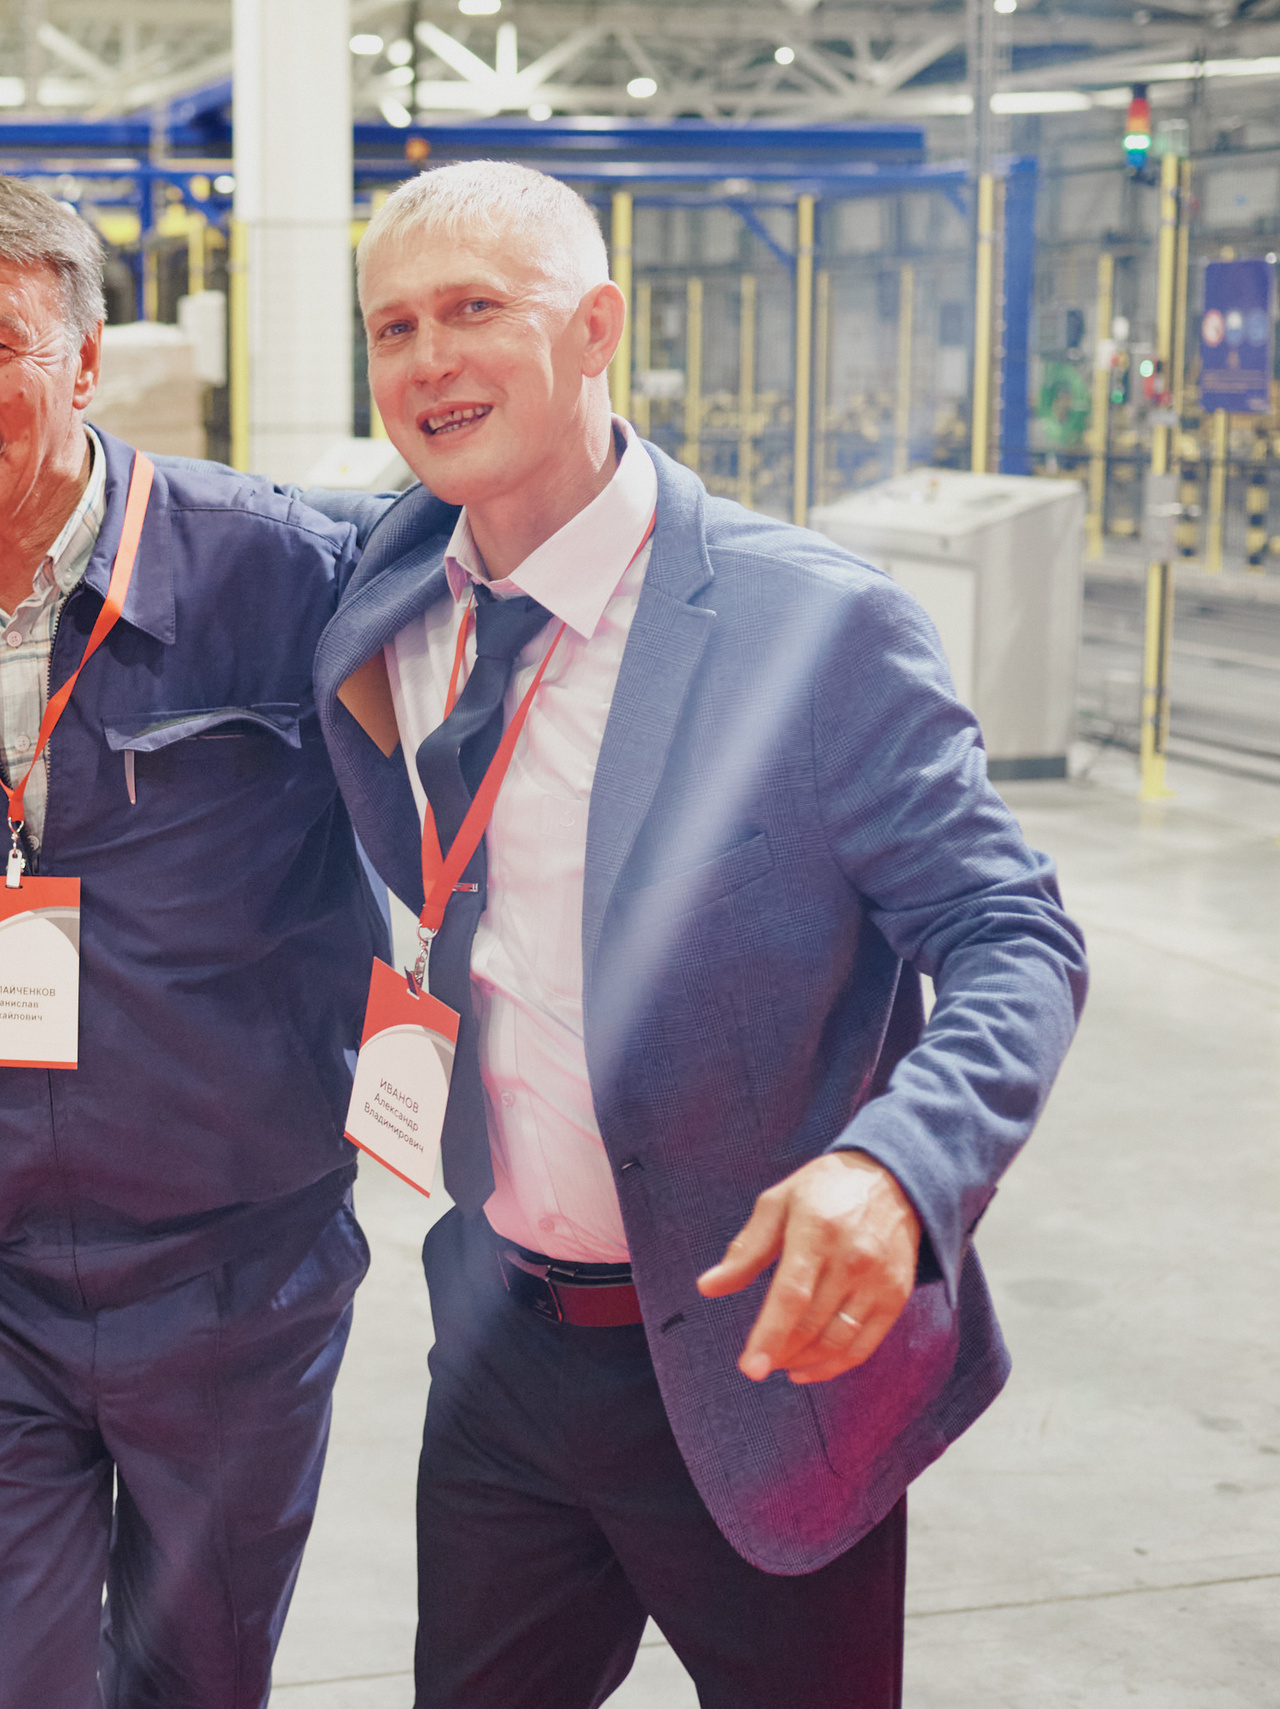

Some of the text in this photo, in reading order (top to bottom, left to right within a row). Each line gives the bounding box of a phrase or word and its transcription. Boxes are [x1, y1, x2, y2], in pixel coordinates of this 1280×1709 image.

[374, 1093, 419, 1131] Александр
[380, 1078, 419, 1113] ИВАНОВ
[364, 1102, 424, 1153] Владимирович
